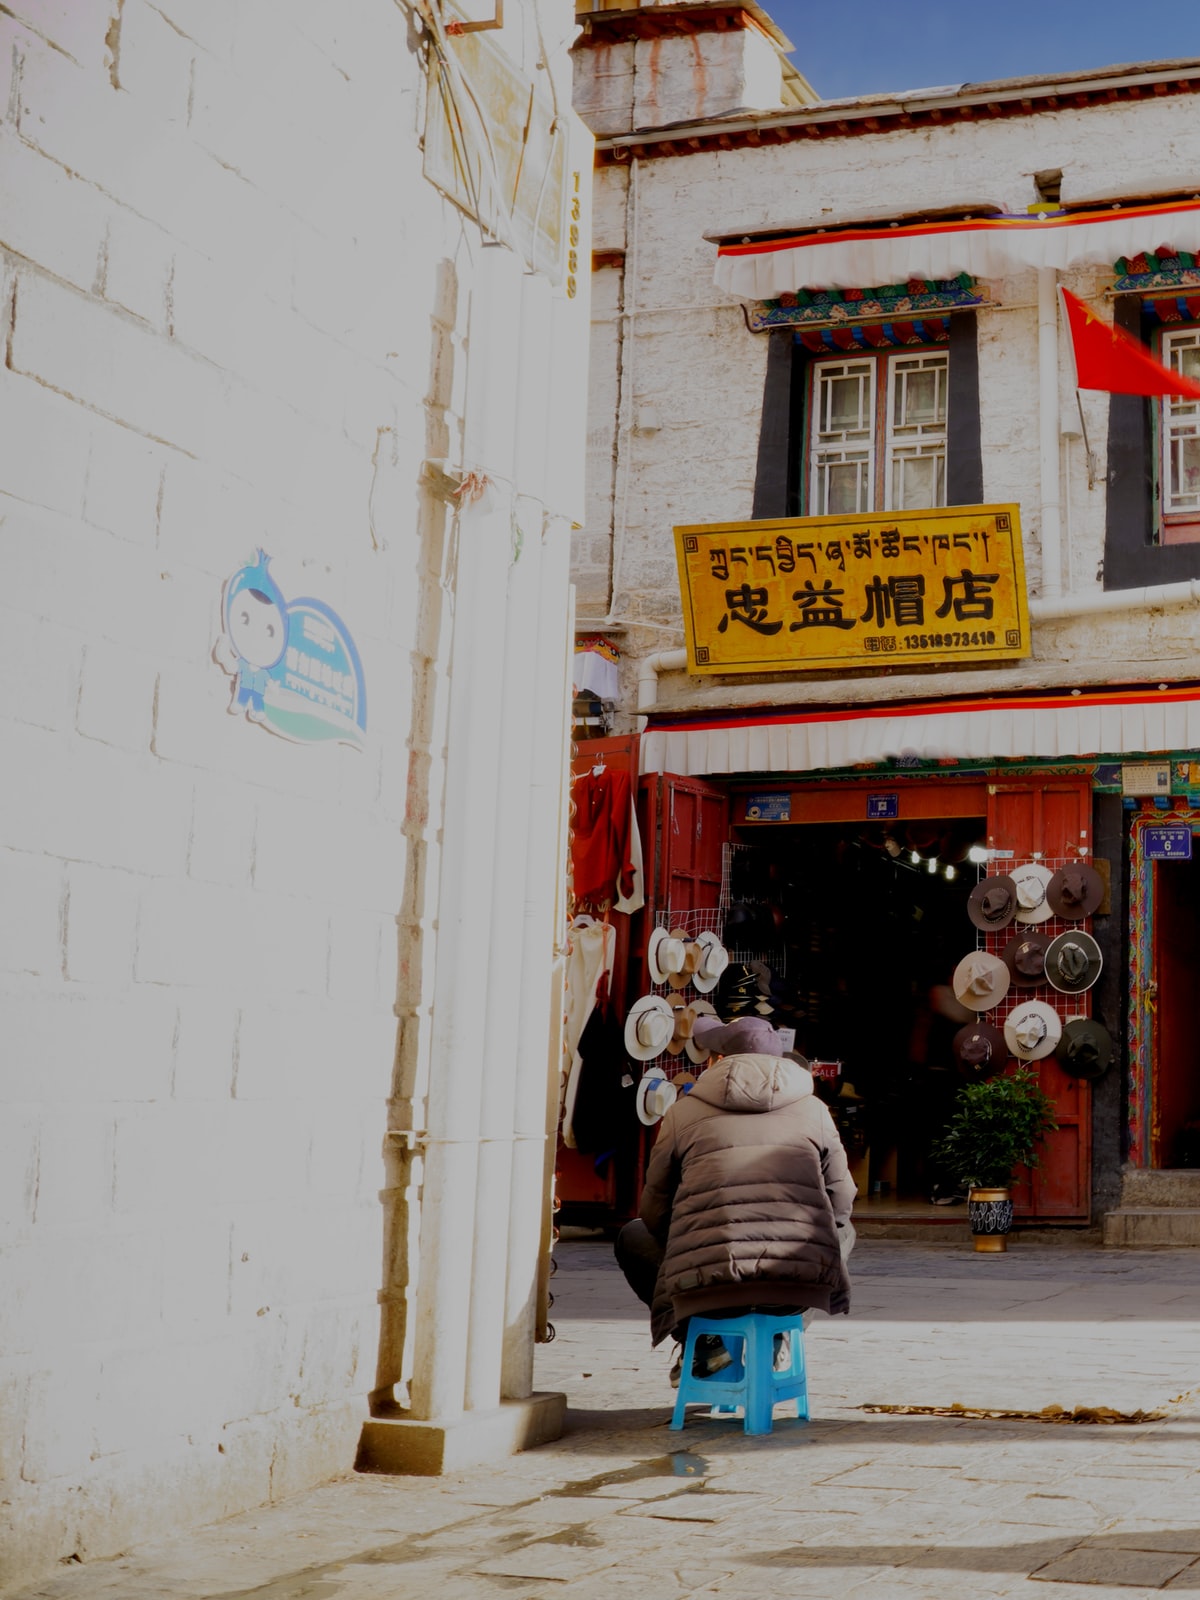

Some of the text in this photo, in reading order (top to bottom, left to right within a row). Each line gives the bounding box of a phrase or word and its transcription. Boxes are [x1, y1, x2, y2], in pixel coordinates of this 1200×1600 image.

[717, 568, 1000, 636] 忠益帽店
[1164, 840, 1172, 851] 6
[815, 1069, 835, 1078] SALE
